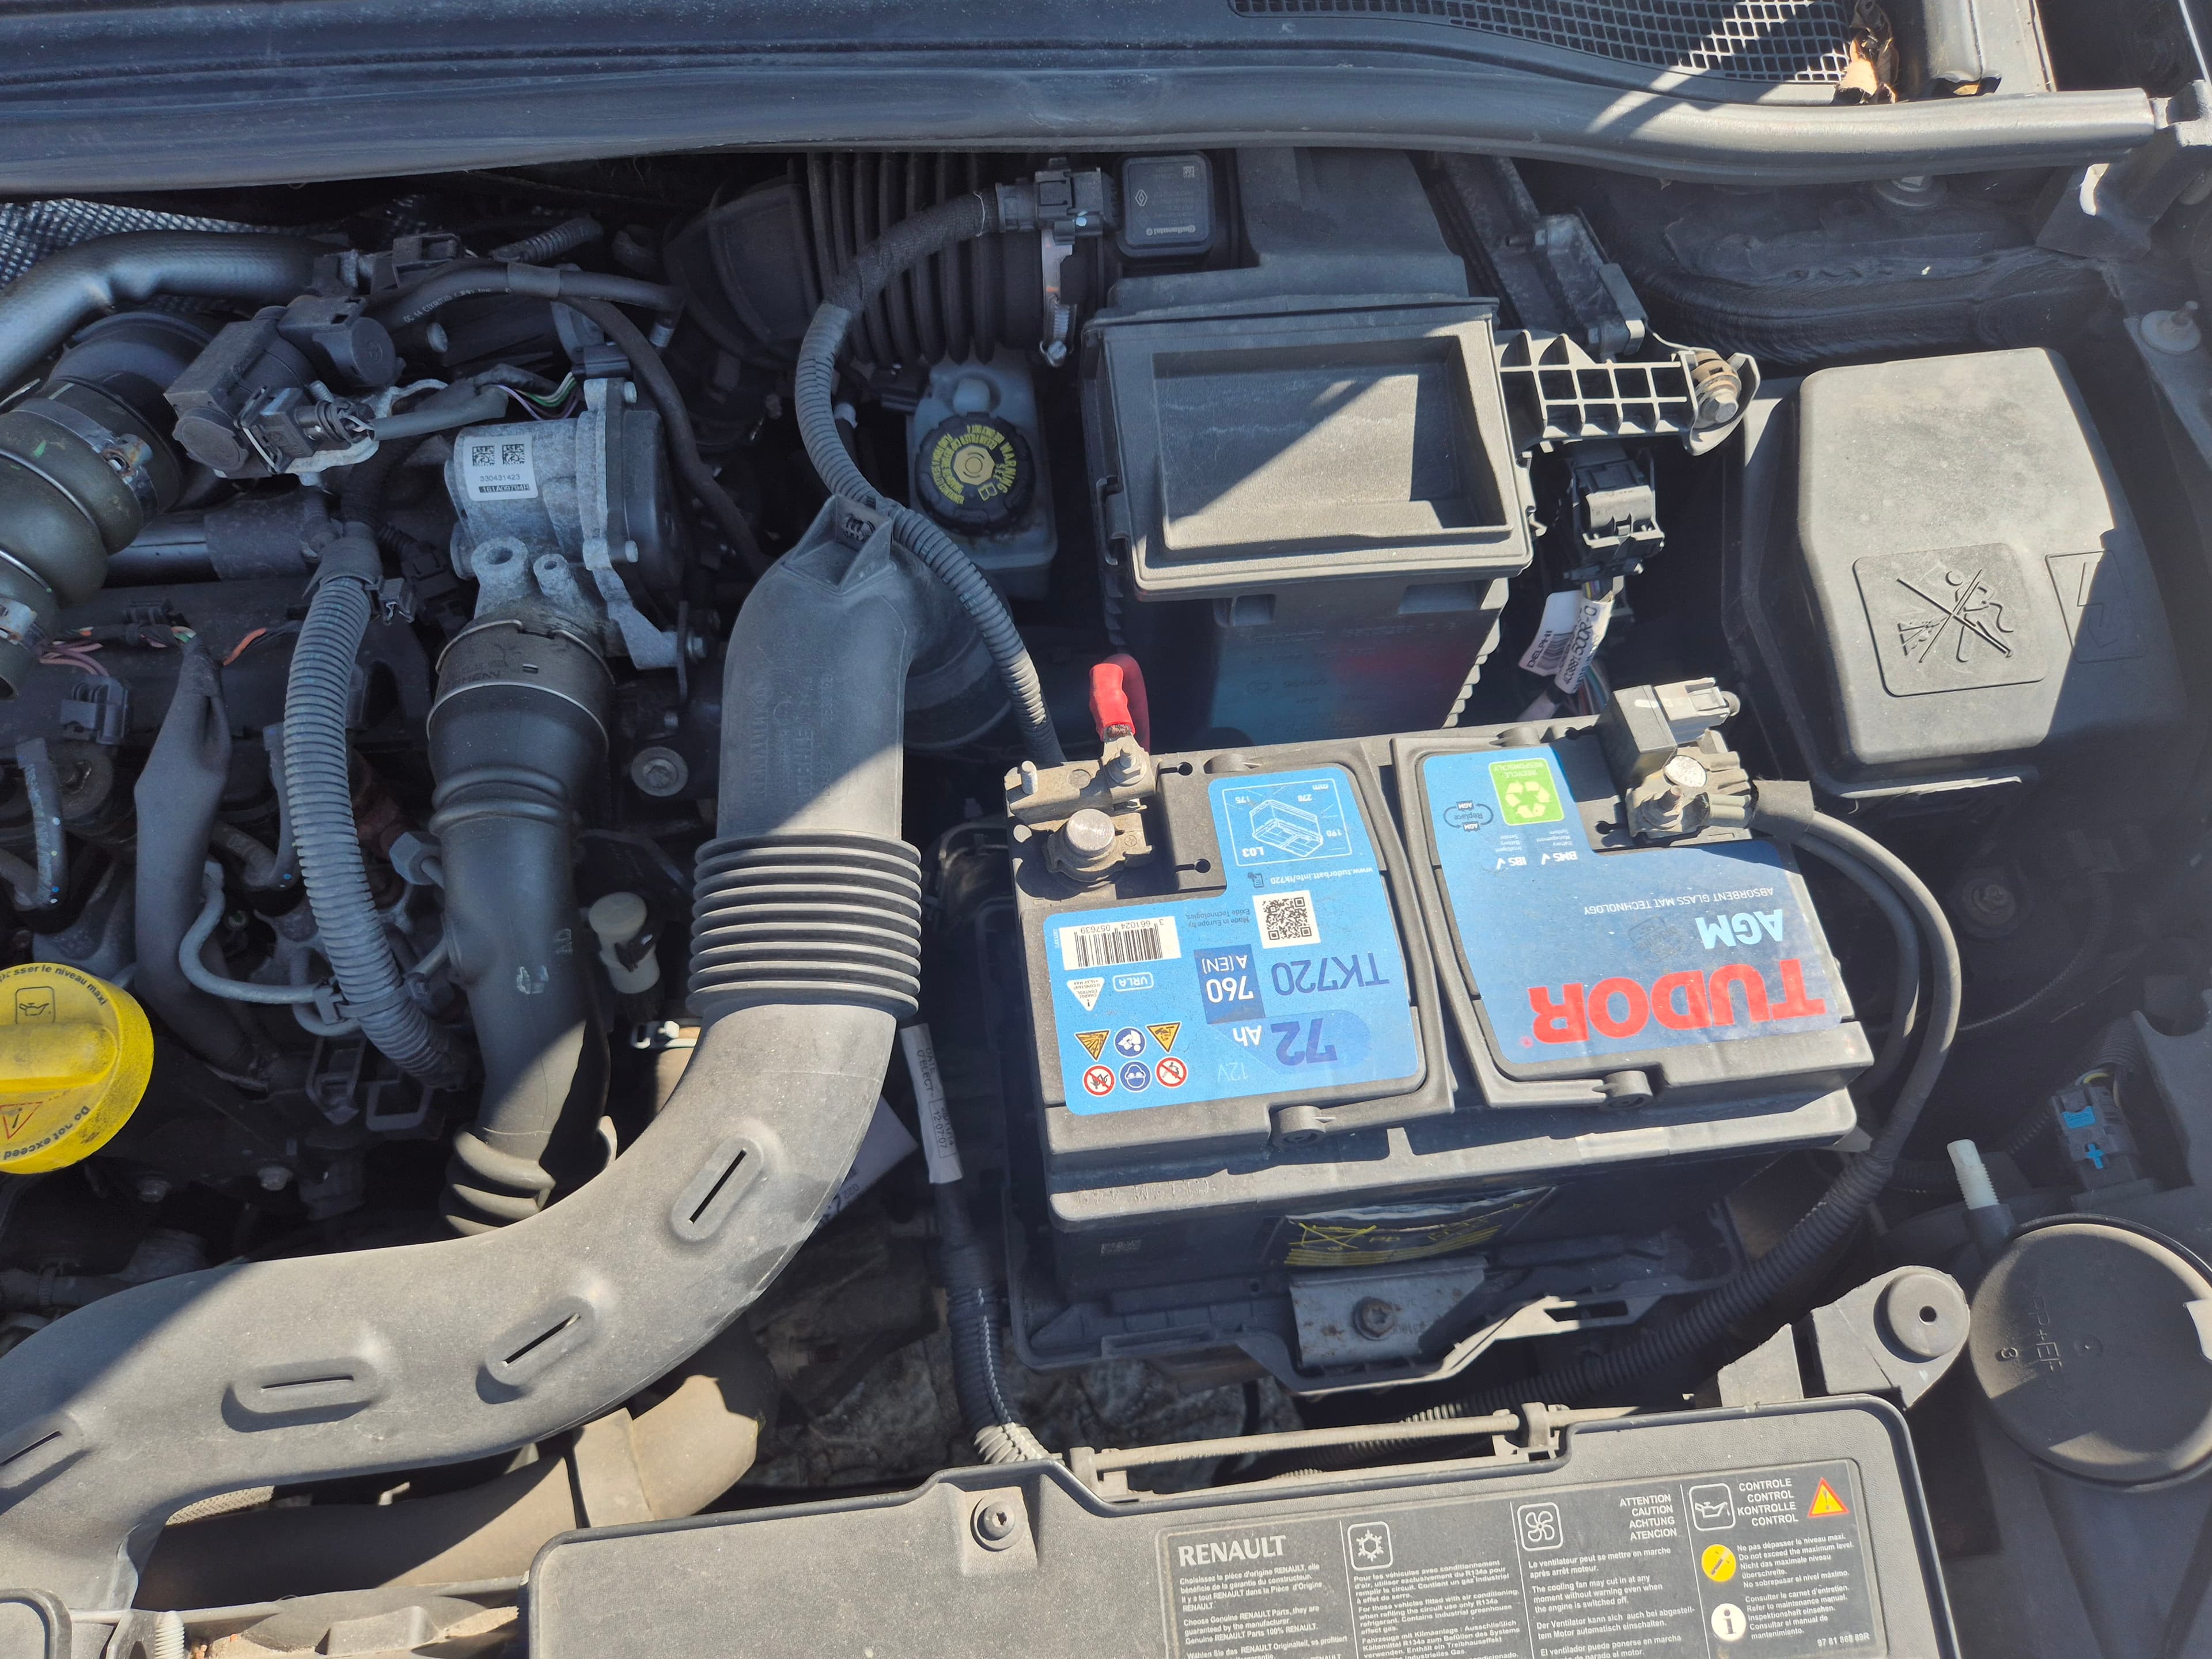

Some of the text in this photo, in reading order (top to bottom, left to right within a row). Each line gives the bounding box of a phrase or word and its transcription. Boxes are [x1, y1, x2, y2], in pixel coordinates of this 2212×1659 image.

[993, 464, 1005, 479] SEE
[1000, 442, 1017, 494] WARNING
[1527, 630, 1552, 669] DELPHI
[1503, 770, 1537, 778] RECYCLE
[1235, 796, 1251, 804] 175
[1297, 794, 1313, 802] 278
[1459, 802, 1473, 810] AGM
[1453, 812, 1484, 821] Replace
[1325, 828, 1343, 837] 190
[1508, 856, 1528, 866] IBS
[1552, 851, 1578, 862] BMS
[1270, 867, 1374, 885] www.tudorbatt.info/tk720
[1584, 887, 1774, 916] ABSORBENT GLASS MAT TECHNOLOGY
[1187, 911, 1230, 920] Technologies
[1080, 924, 1111, 934] 057639
[1120, 920, 1152, 930] 661024
[1198, 919, 1222, 927] Europe
[1695, 908, 1785, 950] AGM
[1202, 955, 1248, 975] A (EN)
[1118, 976, 1149, 988] VRLA
[1271, 953, 1391, 997] TK720
[41, 964, 52, 972] le
[55, 968, 87, 985] niveau
[87, 983, 108, 1005] maxi
[1206, 975, 1255, 1003] 760
[1527, 959, 1827, 1044] TUDOR
[1232, 1018, 1338, 1067] 72 Ah
[1218, 1061, 1249, 1082] 12V
[74, 1105, 90, 1122] Do
[933, 1111, 948, 1149] 12:07:07
[3, 1137, 51, 1160] exceed
[1738, 1478, 1792, 1491] CONTROLE
[1619, 1494, 1672, 1506] ATTENTION
[1747, 1490, 1794, 1502] CONTROL
[1631, 1505, 1673, 1516] CAUTION
[1737, 1502, 1797, 1515] KONTROLLE
[1628, 1516, 1675, 1528] ACHTUNG
[1751, 1513, 1798, 1525] CONTROL
[1630, 1528, 1677, 1540] ATENCION
[1178, 1535, 1286, 1567] RENAULT
[1748, 1544, 1762, 1552] pas
[1763, 1539, 1794, 1550] dépasser
[1763, 1549, 1787, 1557] exceed
[1802, 1544, 1835, 1552] maximum
[1528, 1560, 1537, 1569] Le
[1539, 1556, 1578, 1567] ventilateur
[1579, 1555, 1596, 1564] peut
[1608, 1551, 1631, 1559] mettre
[1643, 1546, 1671, 1556] marche
[1774, 1556, 1807, 1565] maximale
[1530, 1565, 1599, 1579] après arrêt moteur.
[1742, 1569, 1787, 1578] überschreite.
[1755, 1577, 1794, 1588] sobrepasar
[1821, 1570, 1850, 1578] máximo.
[1532, 1585, 1546, 1593] The
[1547, 1582, 1574, 1593] cooling
[1576, 1580, 1588, 1588] fan
[1589, 1580, 1605, 1588] may
[1637, 1575, 1650, 1583] any
[1533, 1594, 1563, 1603] moment
[1565, 1590, 1592, 1600] without
[1593, 1588, 1623, 1598] warning
[1643, 1582, 1663, 1591] when
[1745, 1593, 1779, 1602] Consulter
[1812, 1585, 1849, 1594] d'entretien.
[1548, 1603, 1573, 1613] engine
[1582, 1597, 1615, 1608] switched
[1775, 1597, 1819, 1608] maintenance
[1821, 1594, 1847, 1602] manual.
[1551, 1618, 1586, 1628] Ventilator
[1588, 1615, 1605, 1624] kann
[1607, 1613, 1623, 1622] sich
[1626, 1611, 1644, 1619] auch
[1659, 1605, 1695, 1618] abgestell-
[1748, 1604, 1835, 1621] Inspektionsheft einsehen.
[1749, 1620, 1783, 1630] Consultar
[1793, 1616, 1818, 1624] manual
[1751, 1627, 1804, 1639] mantenimiento.
